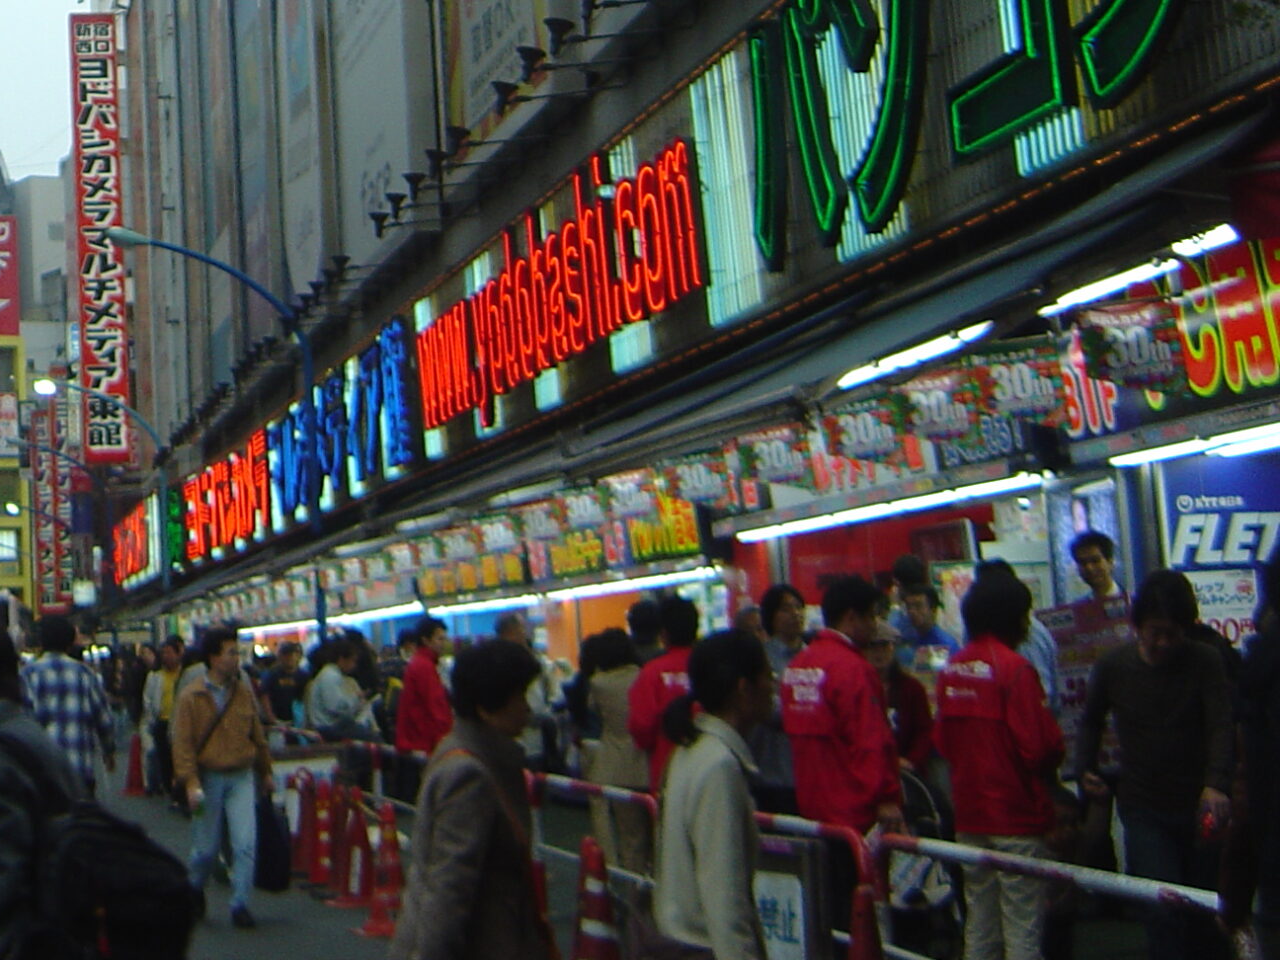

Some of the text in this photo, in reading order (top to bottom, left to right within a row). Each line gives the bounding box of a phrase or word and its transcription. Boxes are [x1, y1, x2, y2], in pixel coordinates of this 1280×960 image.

[75, 23, 109, 39] 新宿
[75, 41, 110, 54] 西口
[414, 136, 707, 432] www.yodobashi.com
